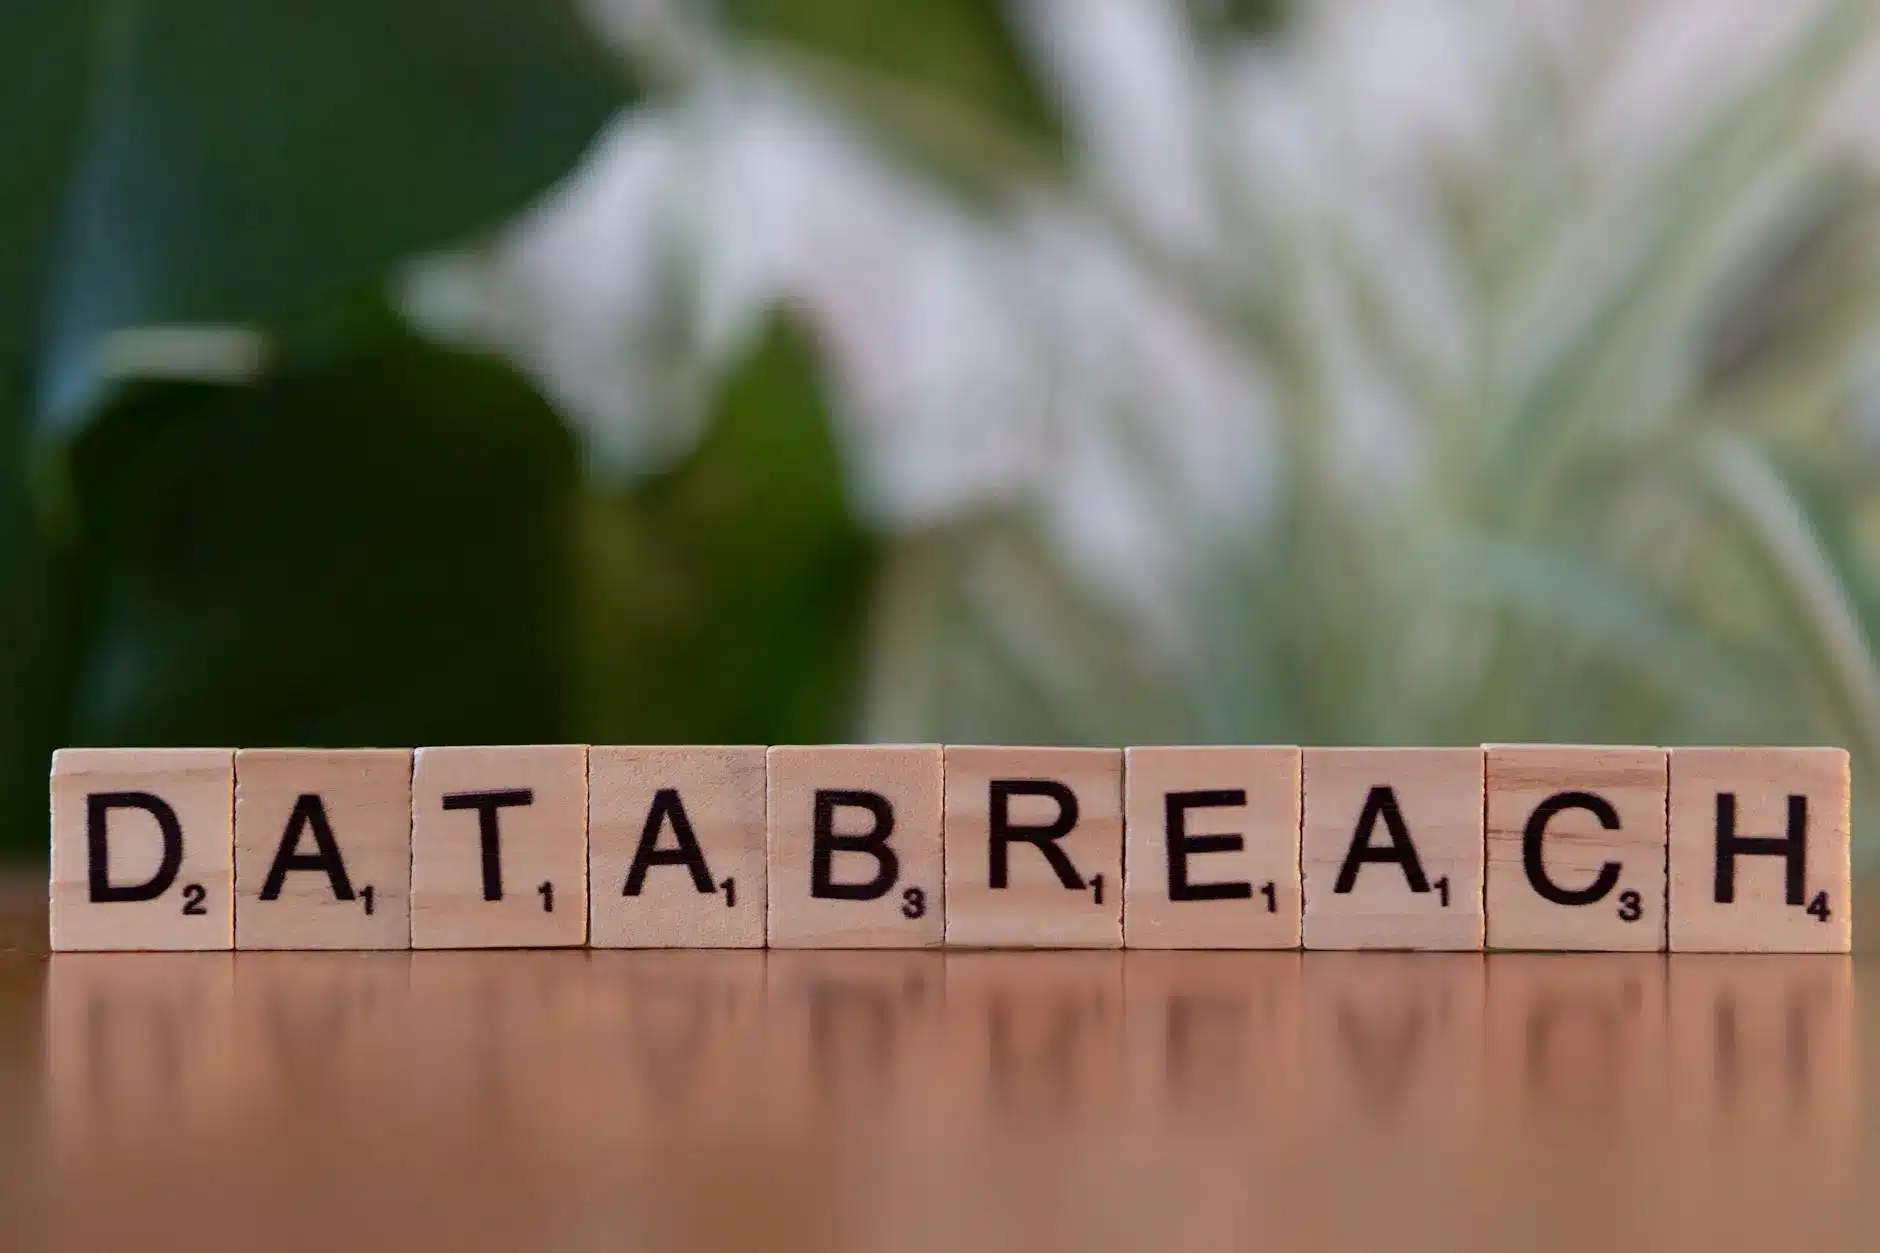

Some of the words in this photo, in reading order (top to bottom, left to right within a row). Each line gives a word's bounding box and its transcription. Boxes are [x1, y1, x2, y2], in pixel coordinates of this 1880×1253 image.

[182, 883, 207, 916] 2
[358, 885, 375, 916] 1
[537, 881, 554, 913] 1
[719, 877, 737, 908] 1
[901, 887, 927, 920] 3
[1087, 873, 1104, 905] 1
[1260, 881, 1277, 914] 1
[1433, 876, 1450, 908] 1
[1618, 890, 1643, 923] 3
[1807, 891, 1831, 923] 4
